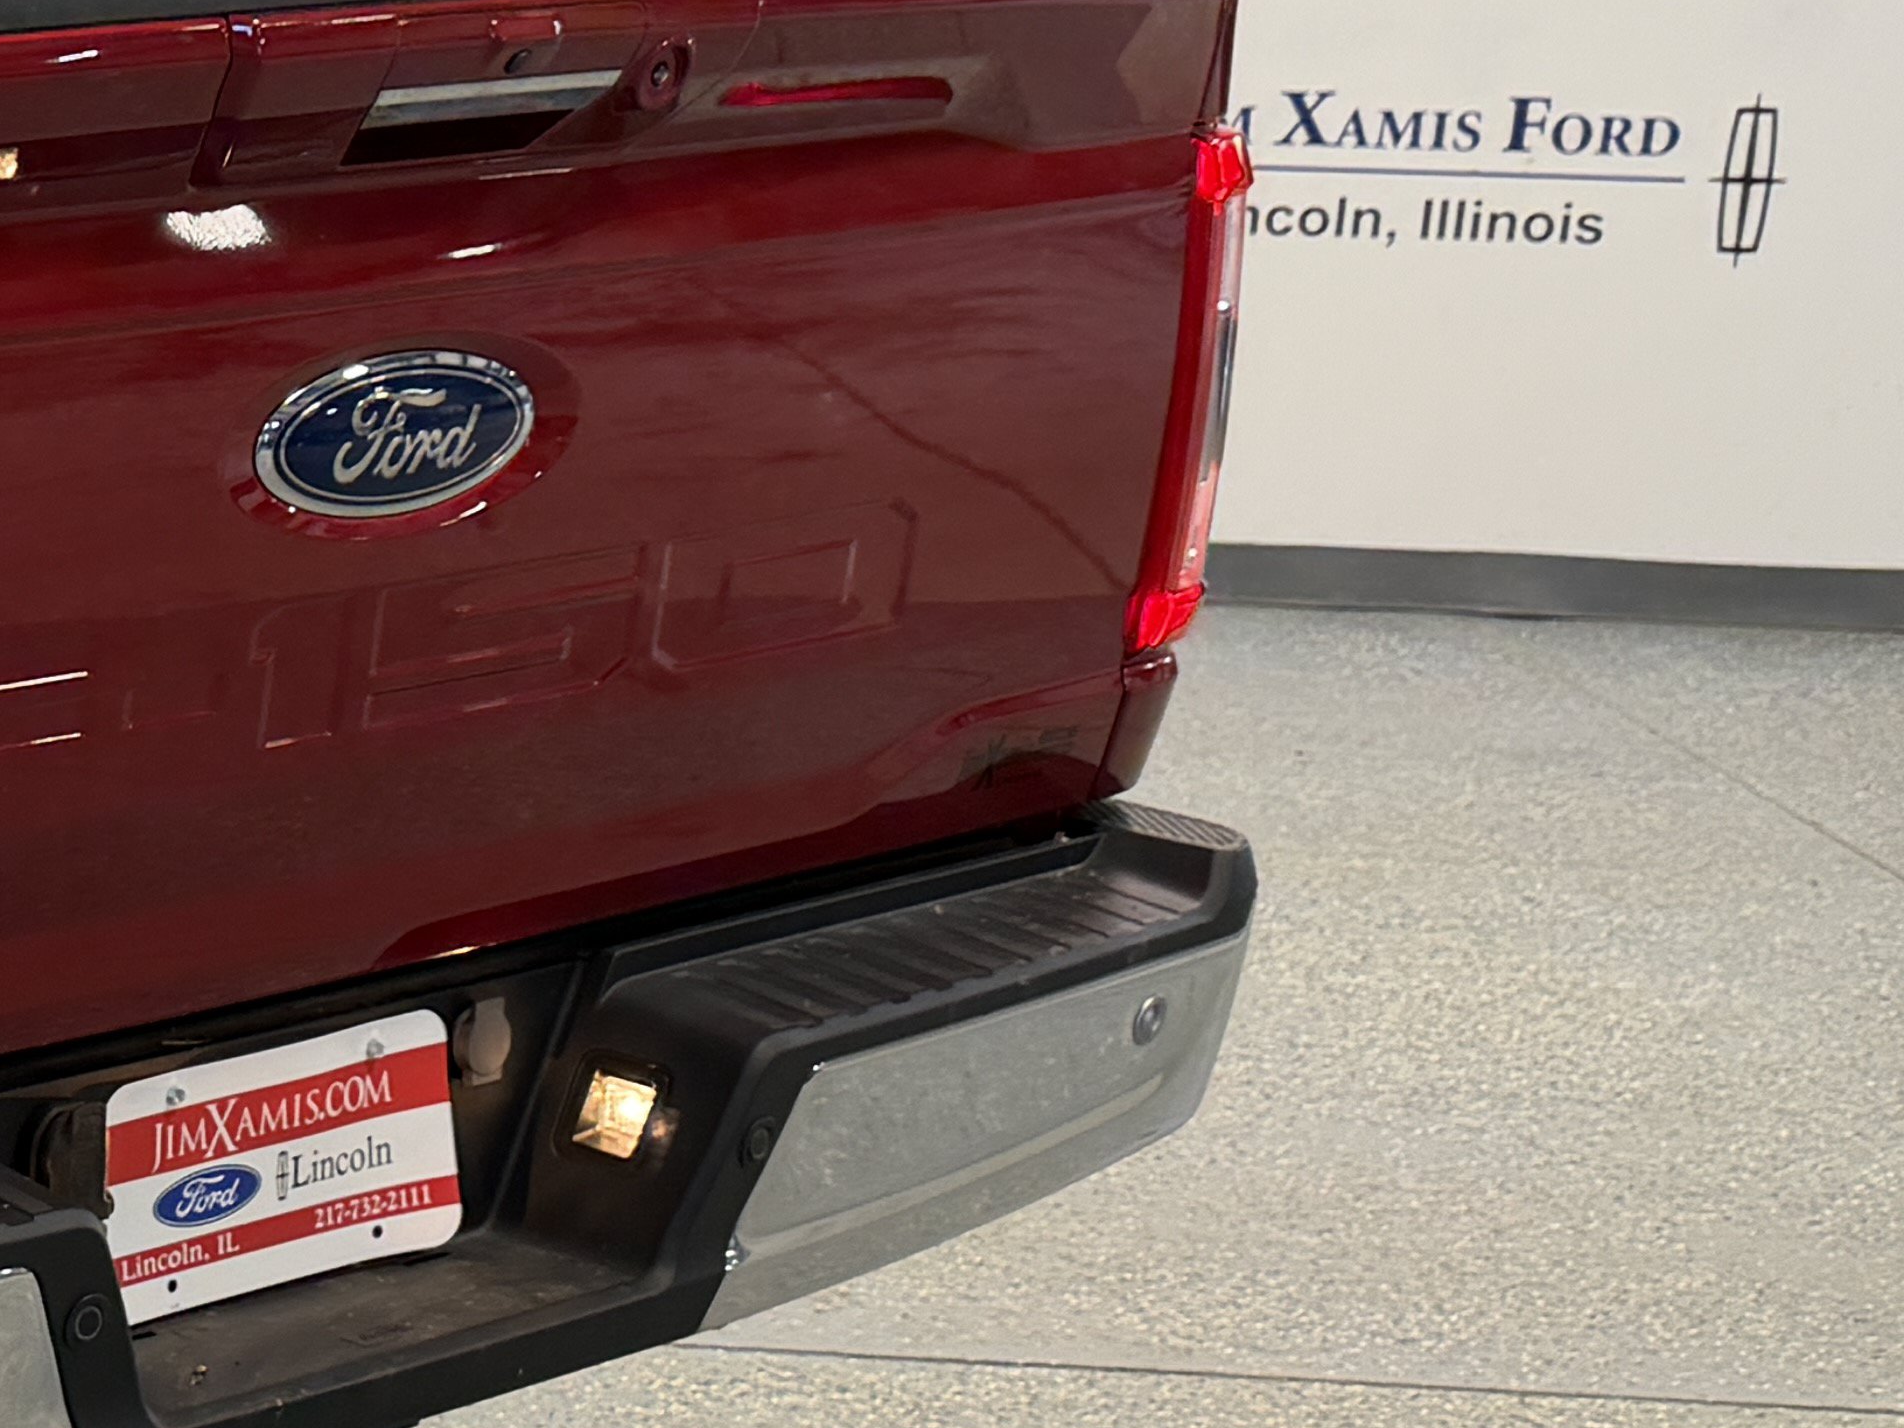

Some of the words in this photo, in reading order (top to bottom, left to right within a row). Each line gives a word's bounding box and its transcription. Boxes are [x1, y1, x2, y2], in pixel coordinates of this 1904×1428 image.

[1419, 199, 1604, 245] Illinois
[333, 386, 482, 484] Ford
[291, 1135, 393, 1189] Lincoln
[175, 1174, 239, 1218] Ford
[314, 1184, 433, 1229] 217-732-2111
[217, 1232, 240, 1255] IL
